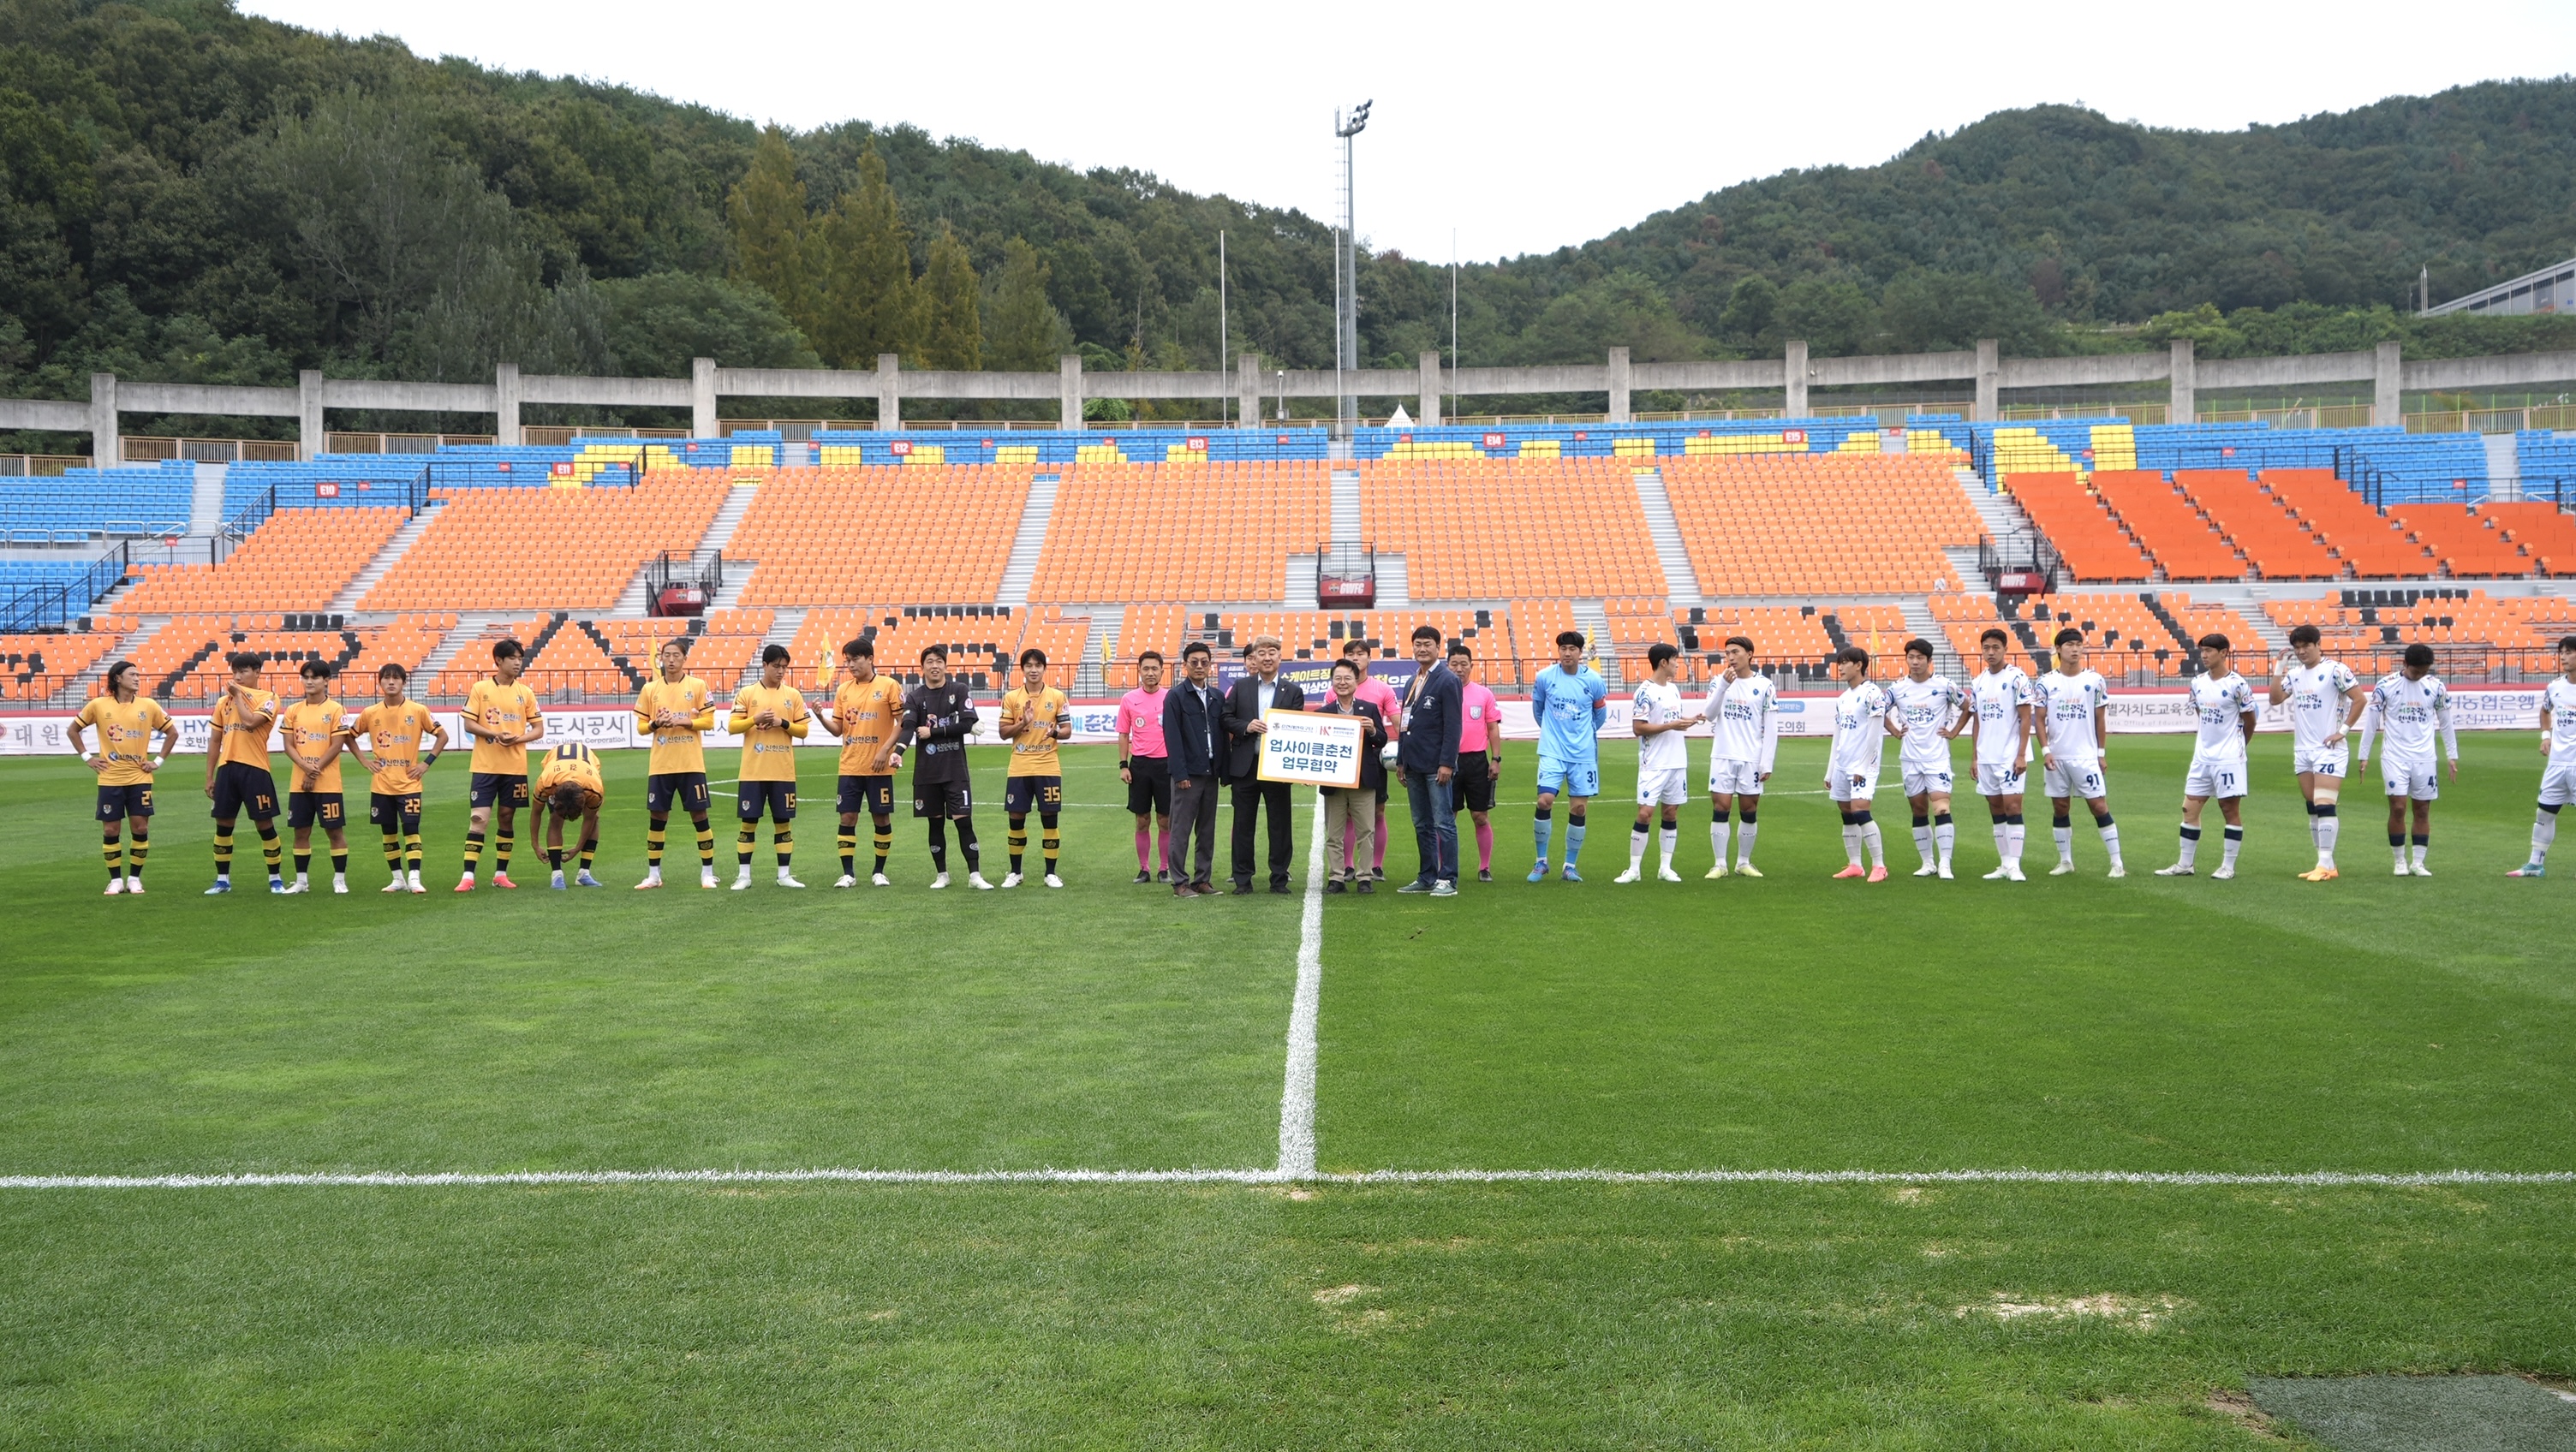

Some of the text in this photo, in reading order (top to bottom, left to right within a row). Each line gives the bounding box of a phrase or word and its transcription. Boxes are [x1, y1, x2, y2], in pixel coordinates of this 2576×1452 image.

[1190, 439, 1204, 449] E13
[1486, 436, 1501, 445] E14
[1786, 432, 1801, 442] E15
[894, 443, 909, 453] E12
[319, 485, 336, 496] E10
[1339, 582, 1364, 594] GWFC
[859, 711, 878, 720] 춘천시
[308, 732, 327, 741] 춘천시
[668, 735, 694, 744] 신한은행
[1270, 739, 1352, 759] 업사이클춘천
[386, 759, 410, 768] 신한은행
[1282, 756, 1338, 774] 업무협약
[1587, 771, 1597, 783] 31
[2086, 773, 2100, 787] 91
[2221, 772, 2235, 786] 71
[513, 783, 528, 799] 28
[695, 783, 707, 800] 11
[880, 788, 890, 804] 6
[962, 789, 969, 806] 1
[1044, 787, 1061, 802] 35
[256, 794, 271, 809] 14
[404, 798, 420, 813] 22
[784, 793, 796, 808] 15
[322, 802, 340, 819] 30
